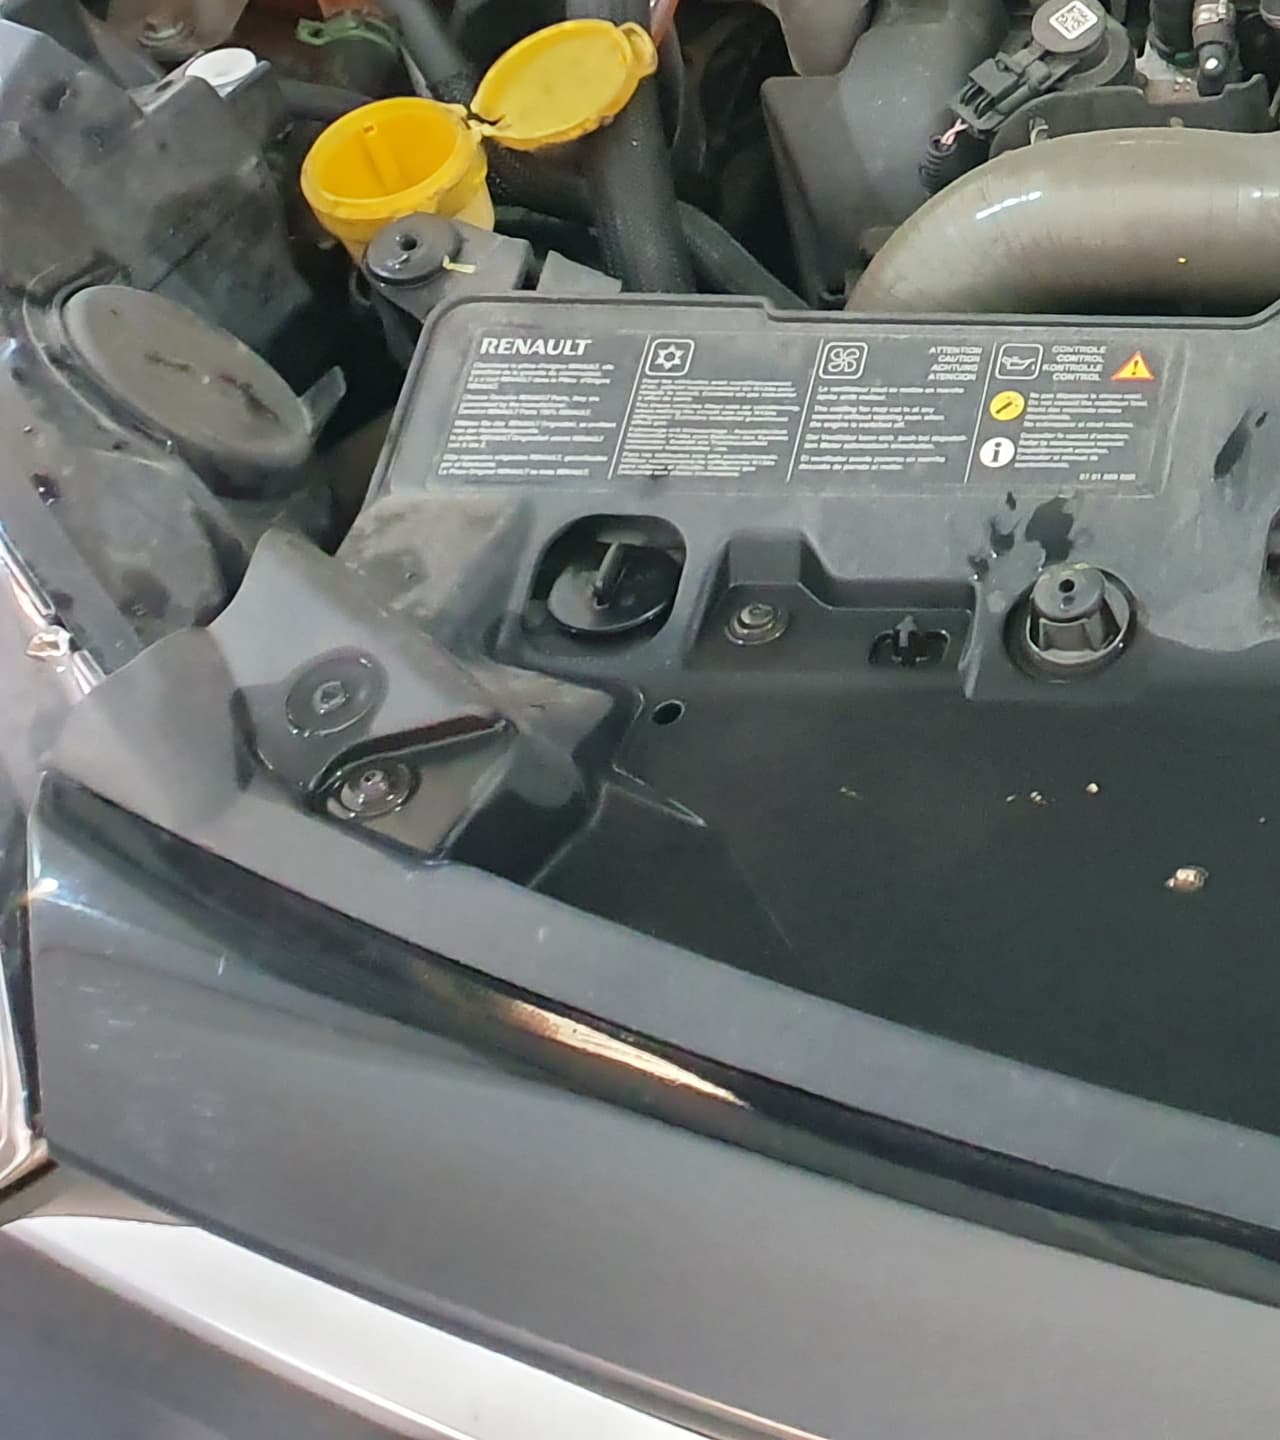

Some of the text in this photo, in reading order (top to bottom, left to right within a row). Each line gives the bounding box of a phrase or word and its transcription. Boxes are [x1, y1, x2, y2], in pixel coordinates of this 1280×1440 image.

[479, 337, 592, 356] RENAULT
[929, 346, 983, 355] ATTENTION
[938, 355, 981, 363] CAUTION
